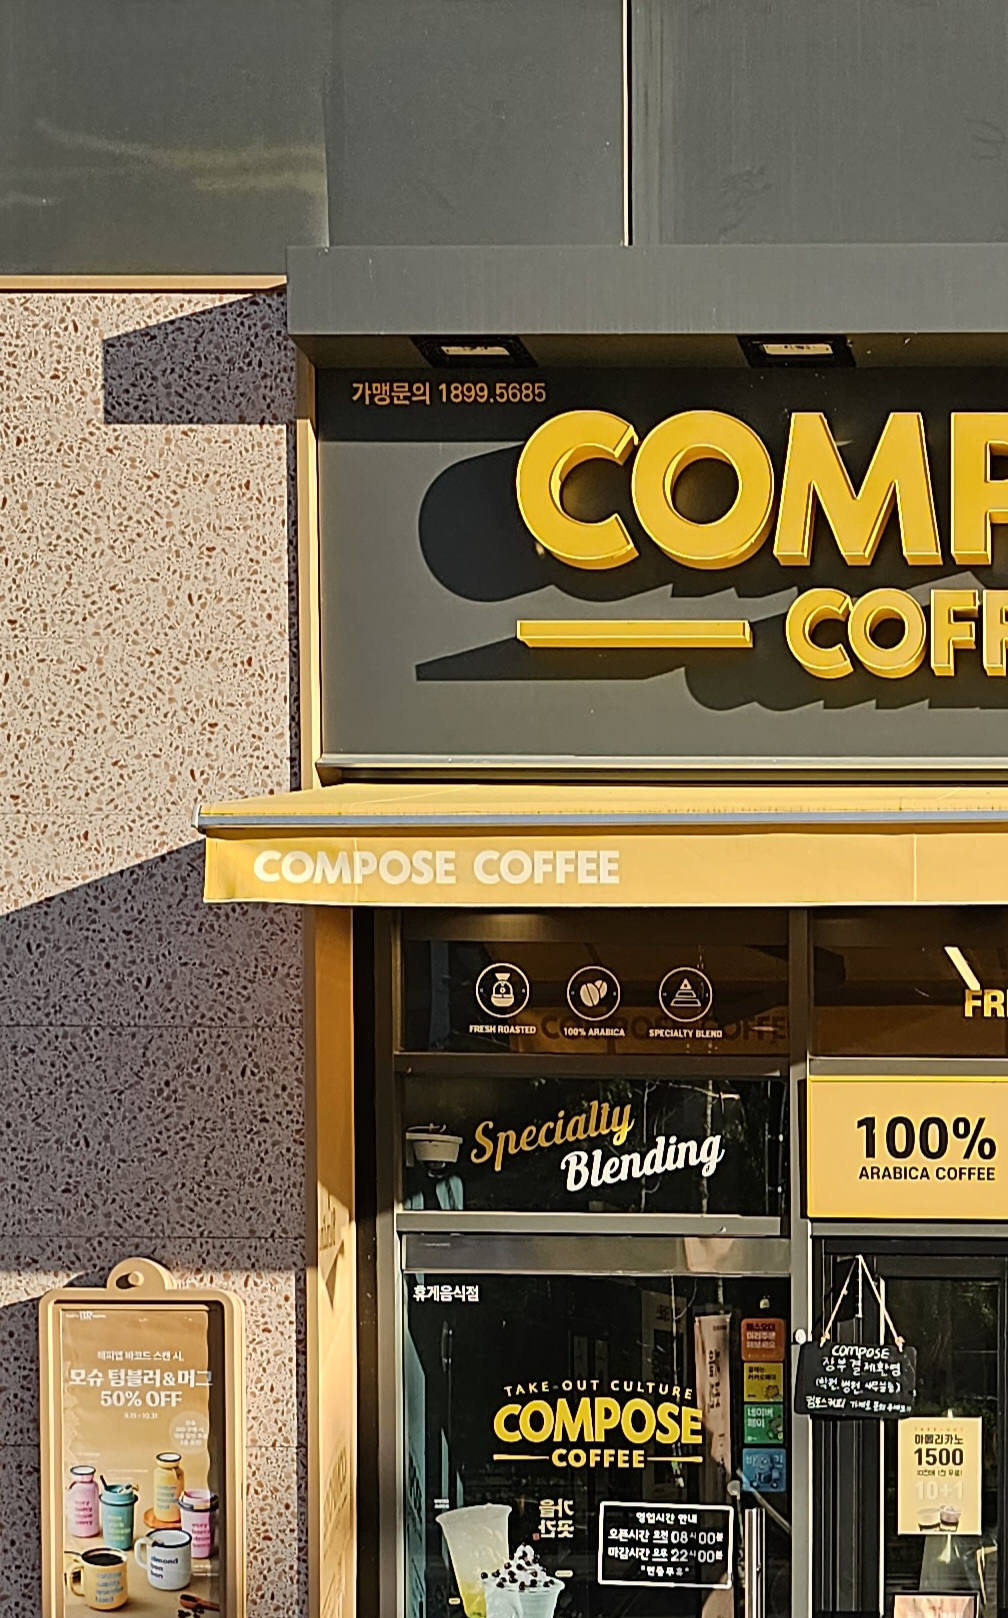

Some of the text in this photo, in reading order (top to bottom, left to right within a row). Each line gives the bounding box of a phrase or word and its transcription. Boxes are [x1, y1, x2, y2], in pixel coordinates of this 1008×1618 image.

[351, 380, 547, 405] 가맹문의 1899.5685
[253, 849, 620, 885] COMPOSE COFFEE
[469, 1024, 536, 1035] FRESH ROASTED
[563, 1027, 625, 1037] 100% ARABICA
[648, 1028, 723, 1039] SPECIALTY BLEND
[471, 1099, 635, 1172] Specialty
[856, 1116, 997, 1161] 100%
[560, 1134, 725, 1192] Blending
[858, 1166, 996, 1181] ARABICA COFFEE
[413, 1284, 480, 1303] 휴게음식점
[69, 1369, 104, 1387] 모슈
[100, 1390, 183, 1407] 50% OFF
[503, 1379, 693, 1400] TAKE-OUT CULTURE
[493, 1397, 703, 1444] COMPOSE
[748, 1407, 774, 1418] 네이버
[748, 1418, 765, 1429] 페이
[914, 1434, 963, 1445] 아메리카노
[552, 1448, 645, 1467] COFFEE
[914, 1447, 964, 1466] 1500
[915, 1481, 963, 1500] 10+1
[636, 1512, 698, 1524] 영업시간 안내
[608, 1528, 650, 1542] 오픈시간
[608, 1547, 650, 1561] 마감시간
